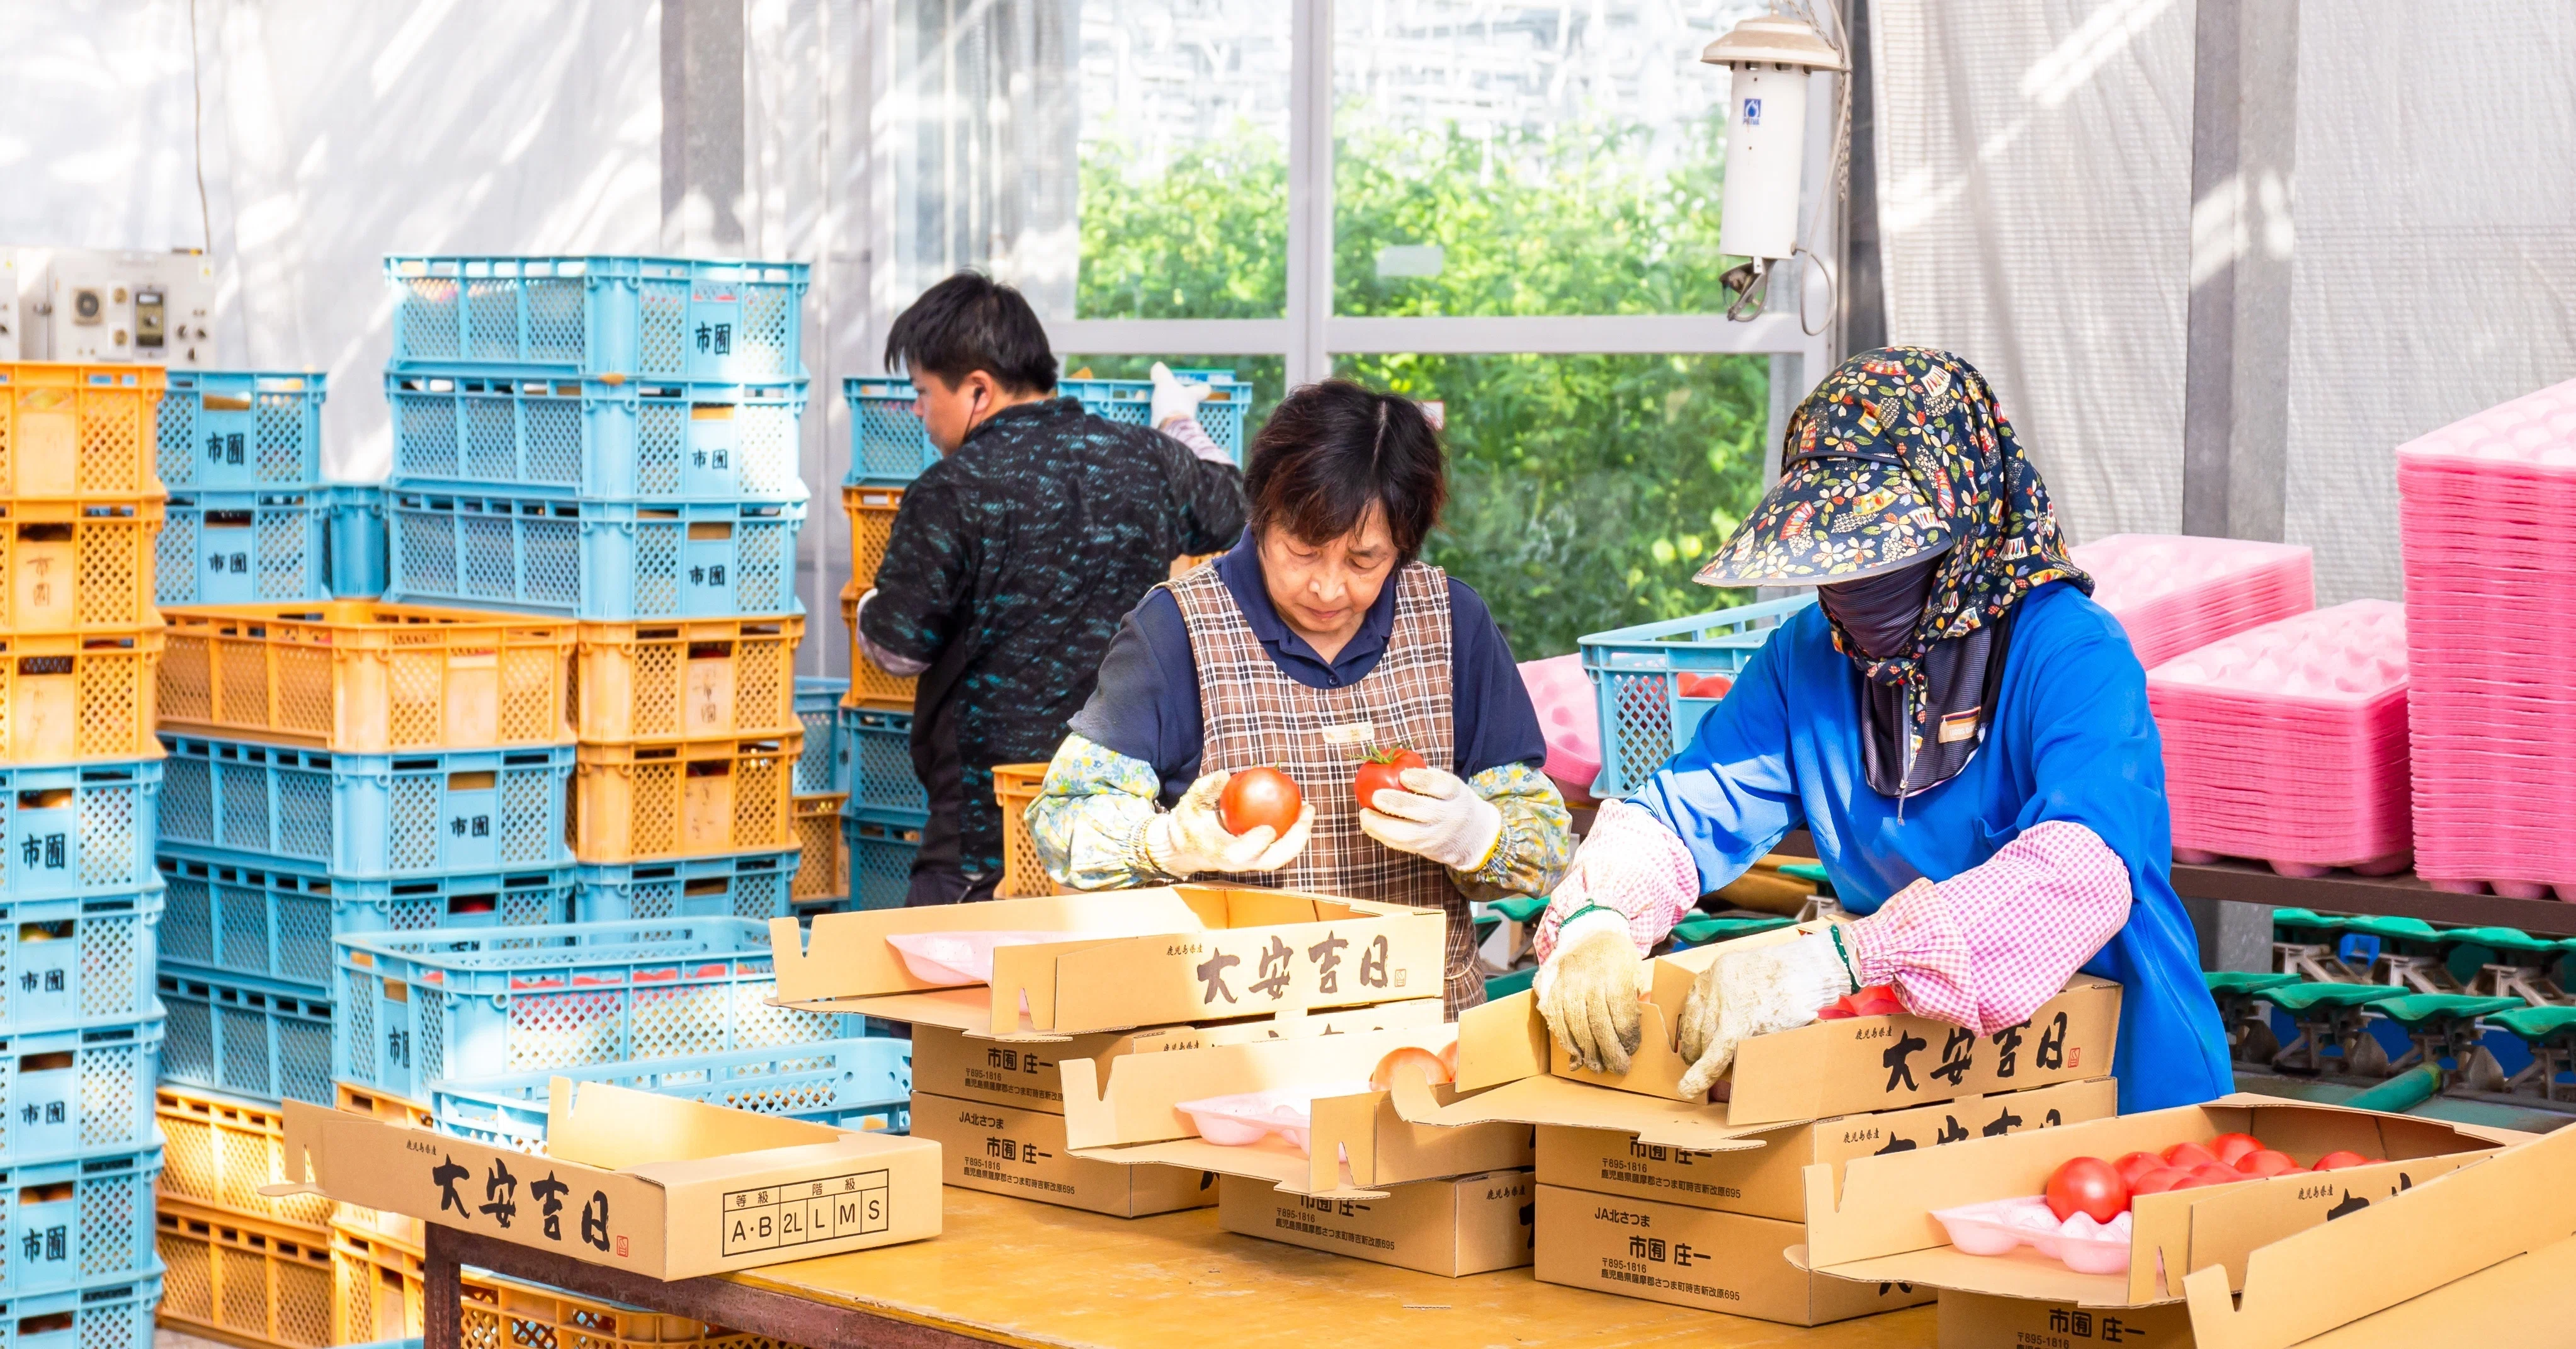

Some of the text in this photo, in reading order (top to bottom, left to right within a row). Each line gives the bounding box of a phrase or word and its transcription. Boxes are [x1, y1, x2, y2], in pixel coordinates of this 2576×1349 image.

[1197, 930, 1389, 1005] 大安吉日
[959, 1112, 1004, 1129] JA北さつま
[432, 1153, 610, 1252] 大安吉日
[784, 1212, 802, 1233] 2L
[815, 1209, 825, 1228] L
[840, 1204, 854, 1224] M
[869, 1200, 879, 1219] S
[1595, 1207, 1650, 1227] JA北さつま
[1674, 1243, 1711, 1266] 庄一
